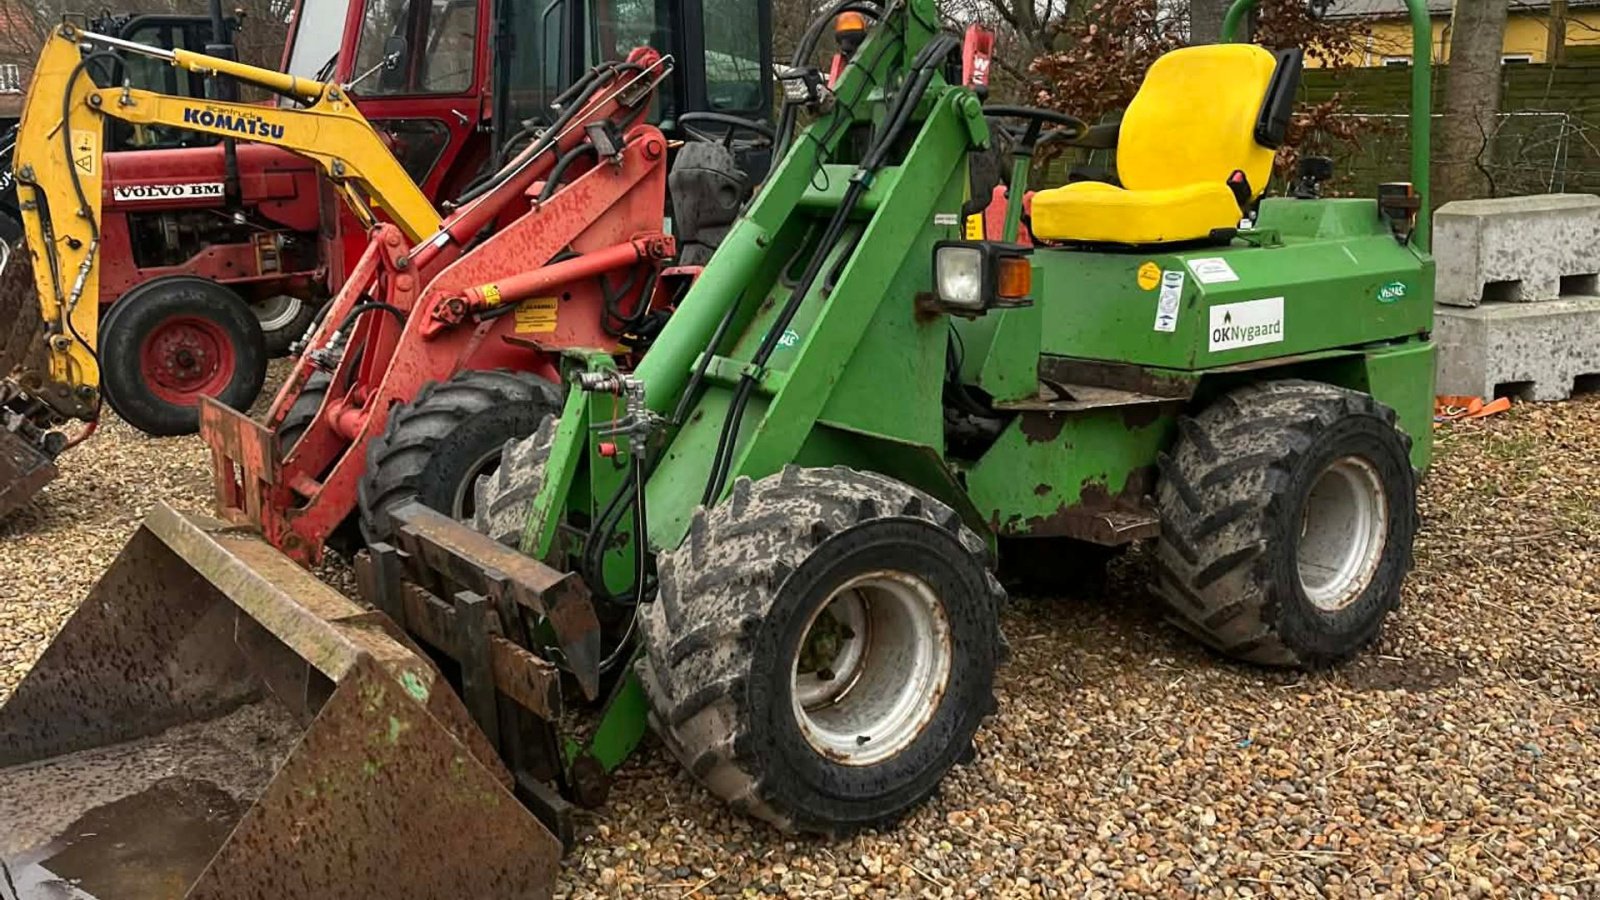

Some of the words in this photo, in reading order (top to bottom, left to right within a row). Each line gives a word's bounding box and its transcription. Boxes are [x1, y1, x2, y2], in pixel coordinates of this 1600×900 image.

[184, 107, 284, 139] KOMATSU
[117, 185, 184, 198] VOLVO
[190, 184, 220, 195] BM
